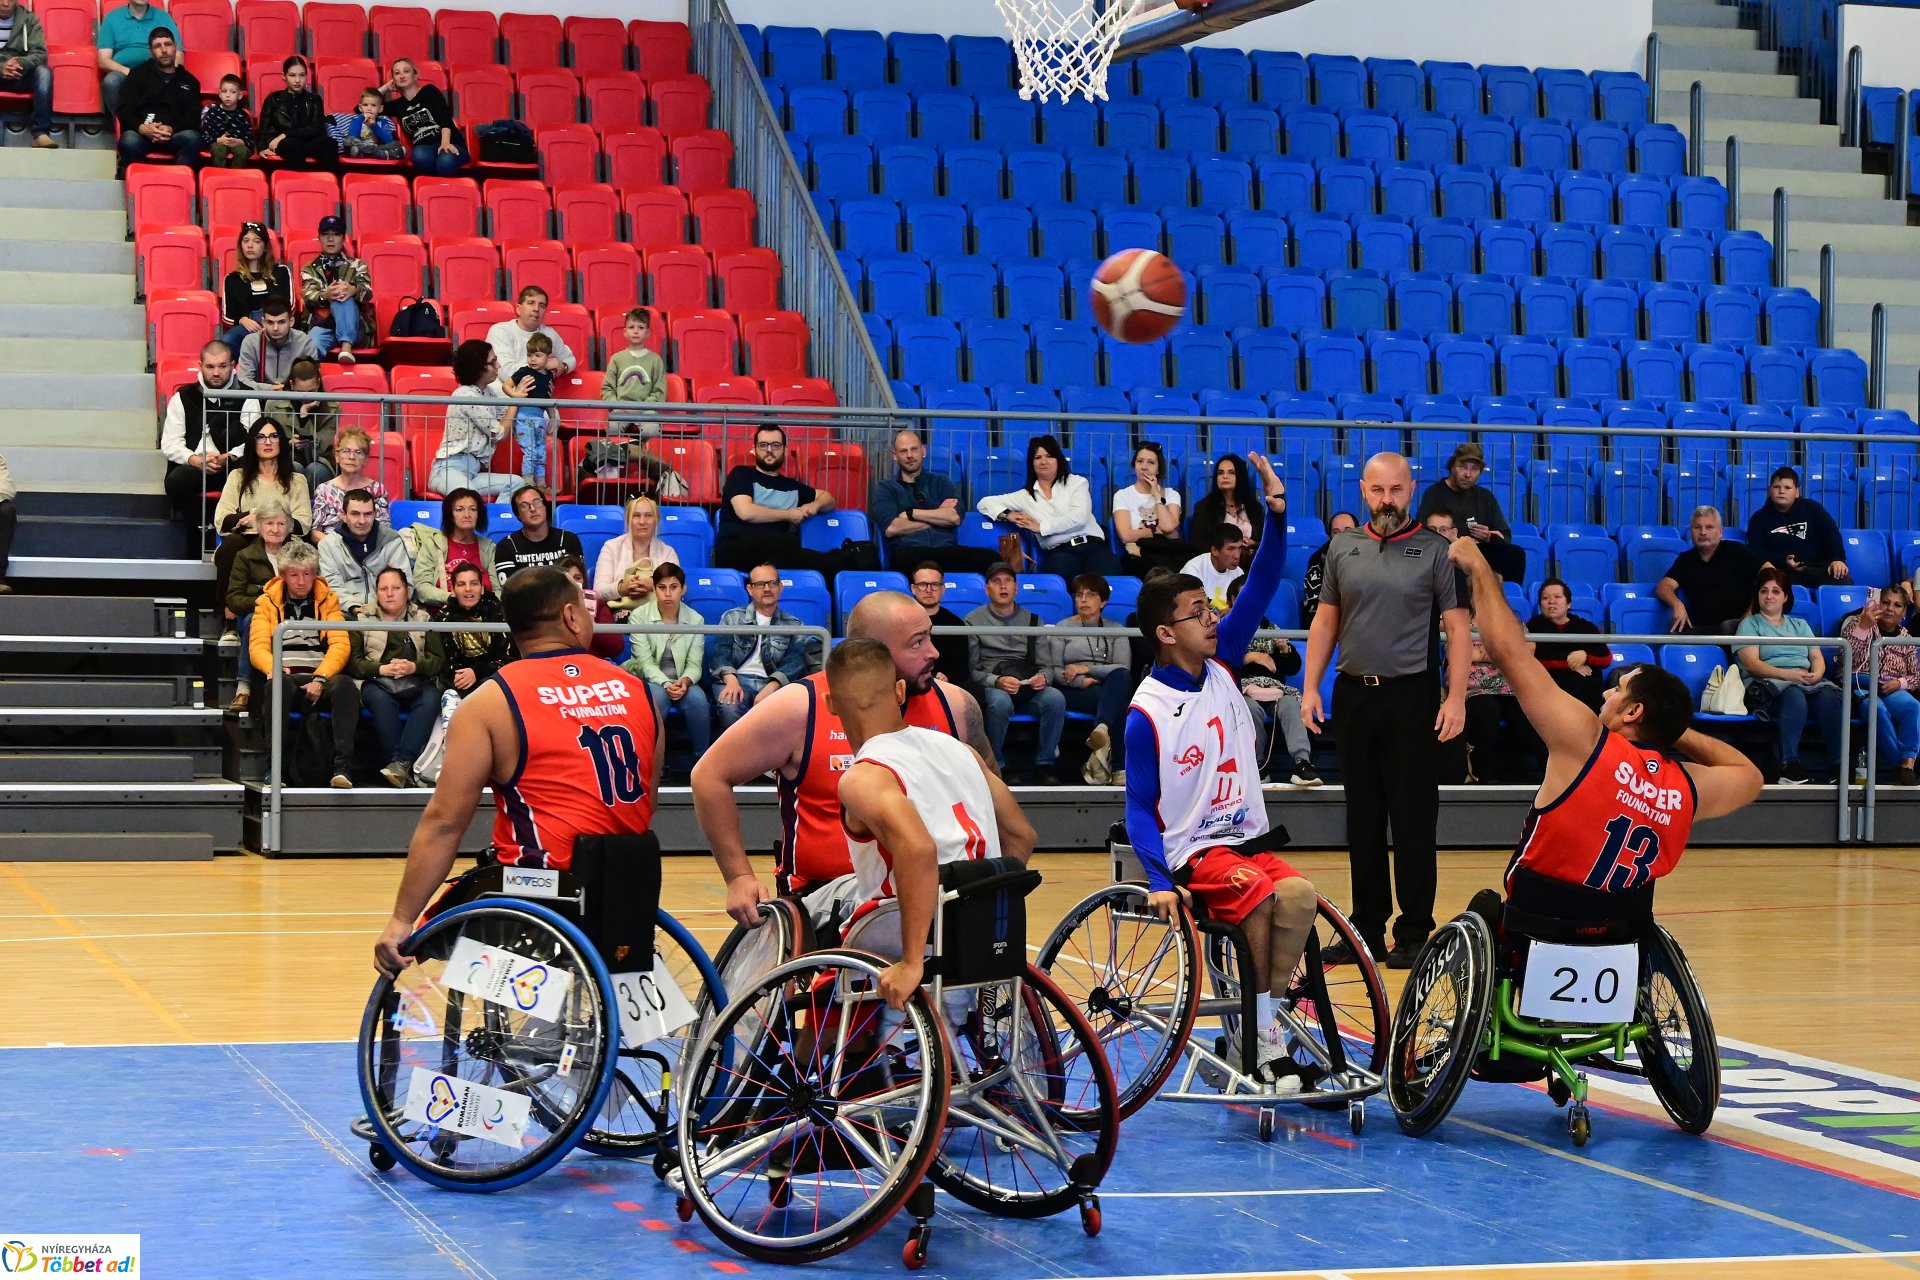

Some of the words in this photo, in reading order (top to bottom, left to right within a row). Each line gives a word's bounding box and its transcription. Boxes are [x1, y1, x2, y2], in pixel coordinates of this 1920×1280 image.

[515, 549, 566, 563] CONTEMPORARY
[537, 679, 631, 705] SUPER
[559, 703, 627, 719] FOUNDATION
[576, 724, 646, 807] 10
[1614, 761, 1682, 810] SUPER
[1615, 788, 1671, 826] FOUNDATION
[1583, 813, 1660, 894] 13
[619, 974, 666, 1022] 3.0
[1549, 966, 1619, 1004] 2.0
[457, 1086, 471, 1128] ROMANIAN
